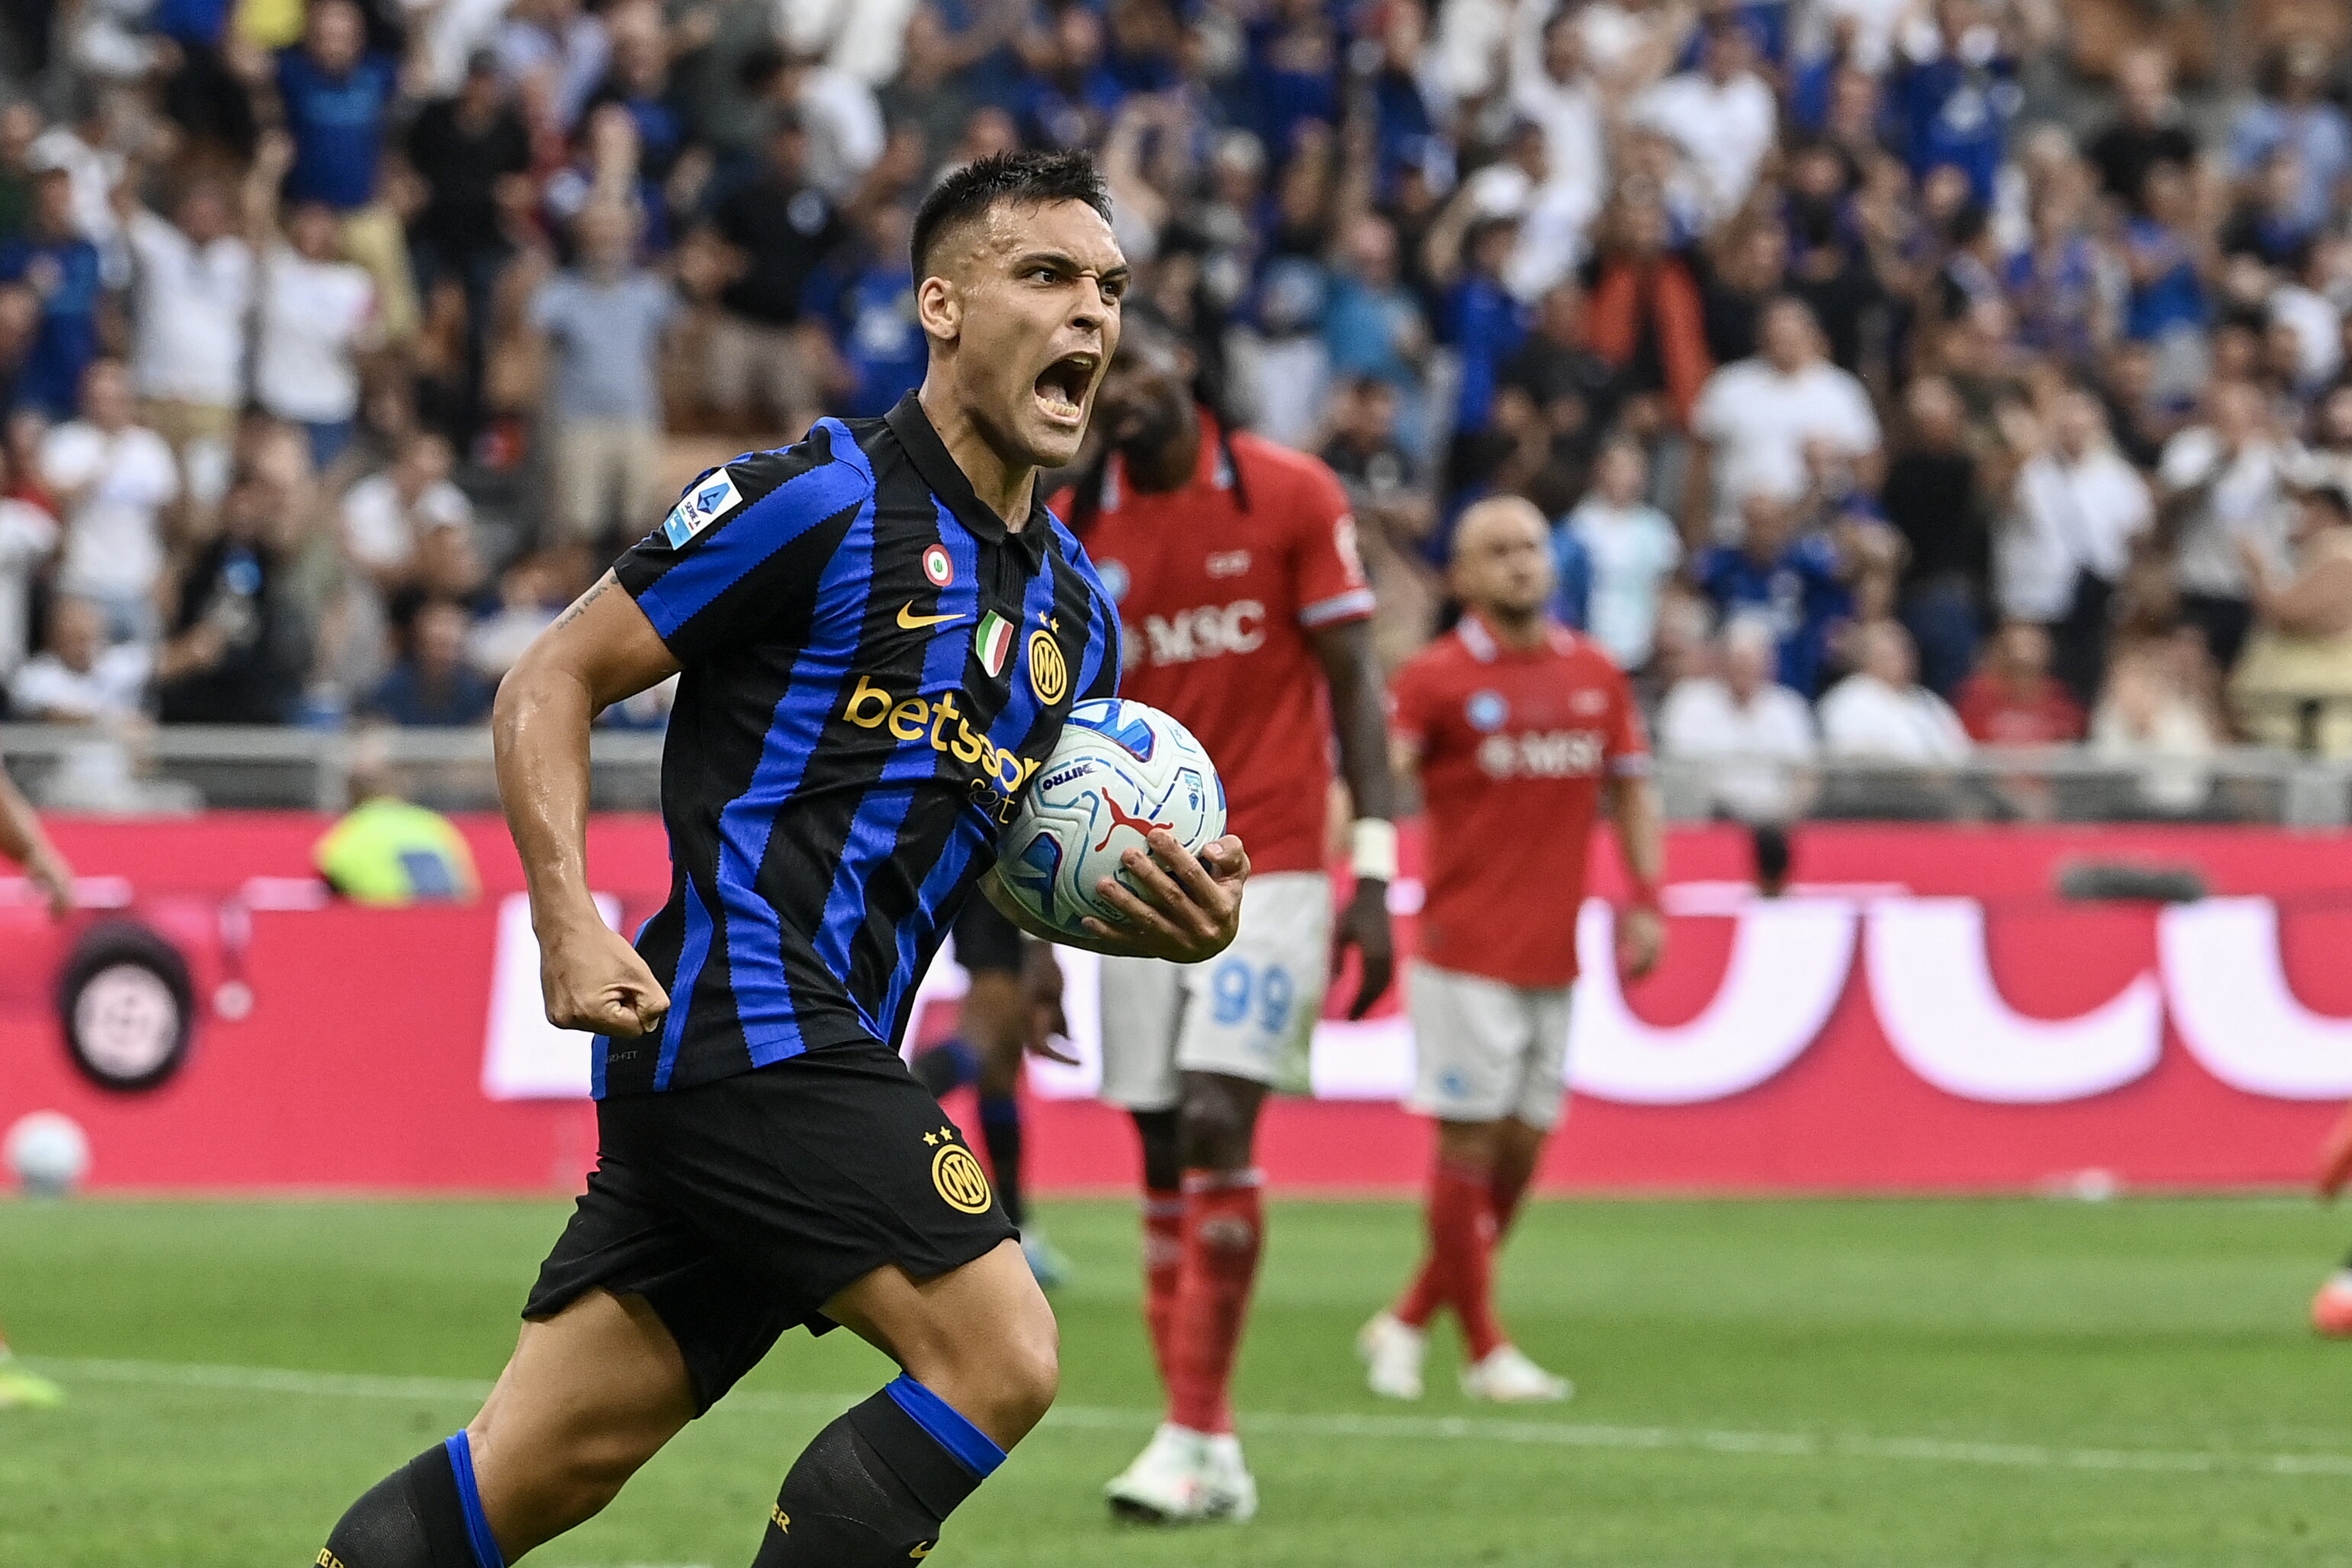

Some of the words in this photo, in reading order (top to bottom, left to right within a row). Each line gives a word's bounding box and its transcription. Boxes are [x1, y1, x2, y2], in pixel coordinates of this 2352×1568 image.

[685, 501, 699, 521] SERIE
[1145, 600, 1265, 667] MSC
[1042, 762, 1097, 790] NITRO
[1212, 958, 1293, 1035] 99
